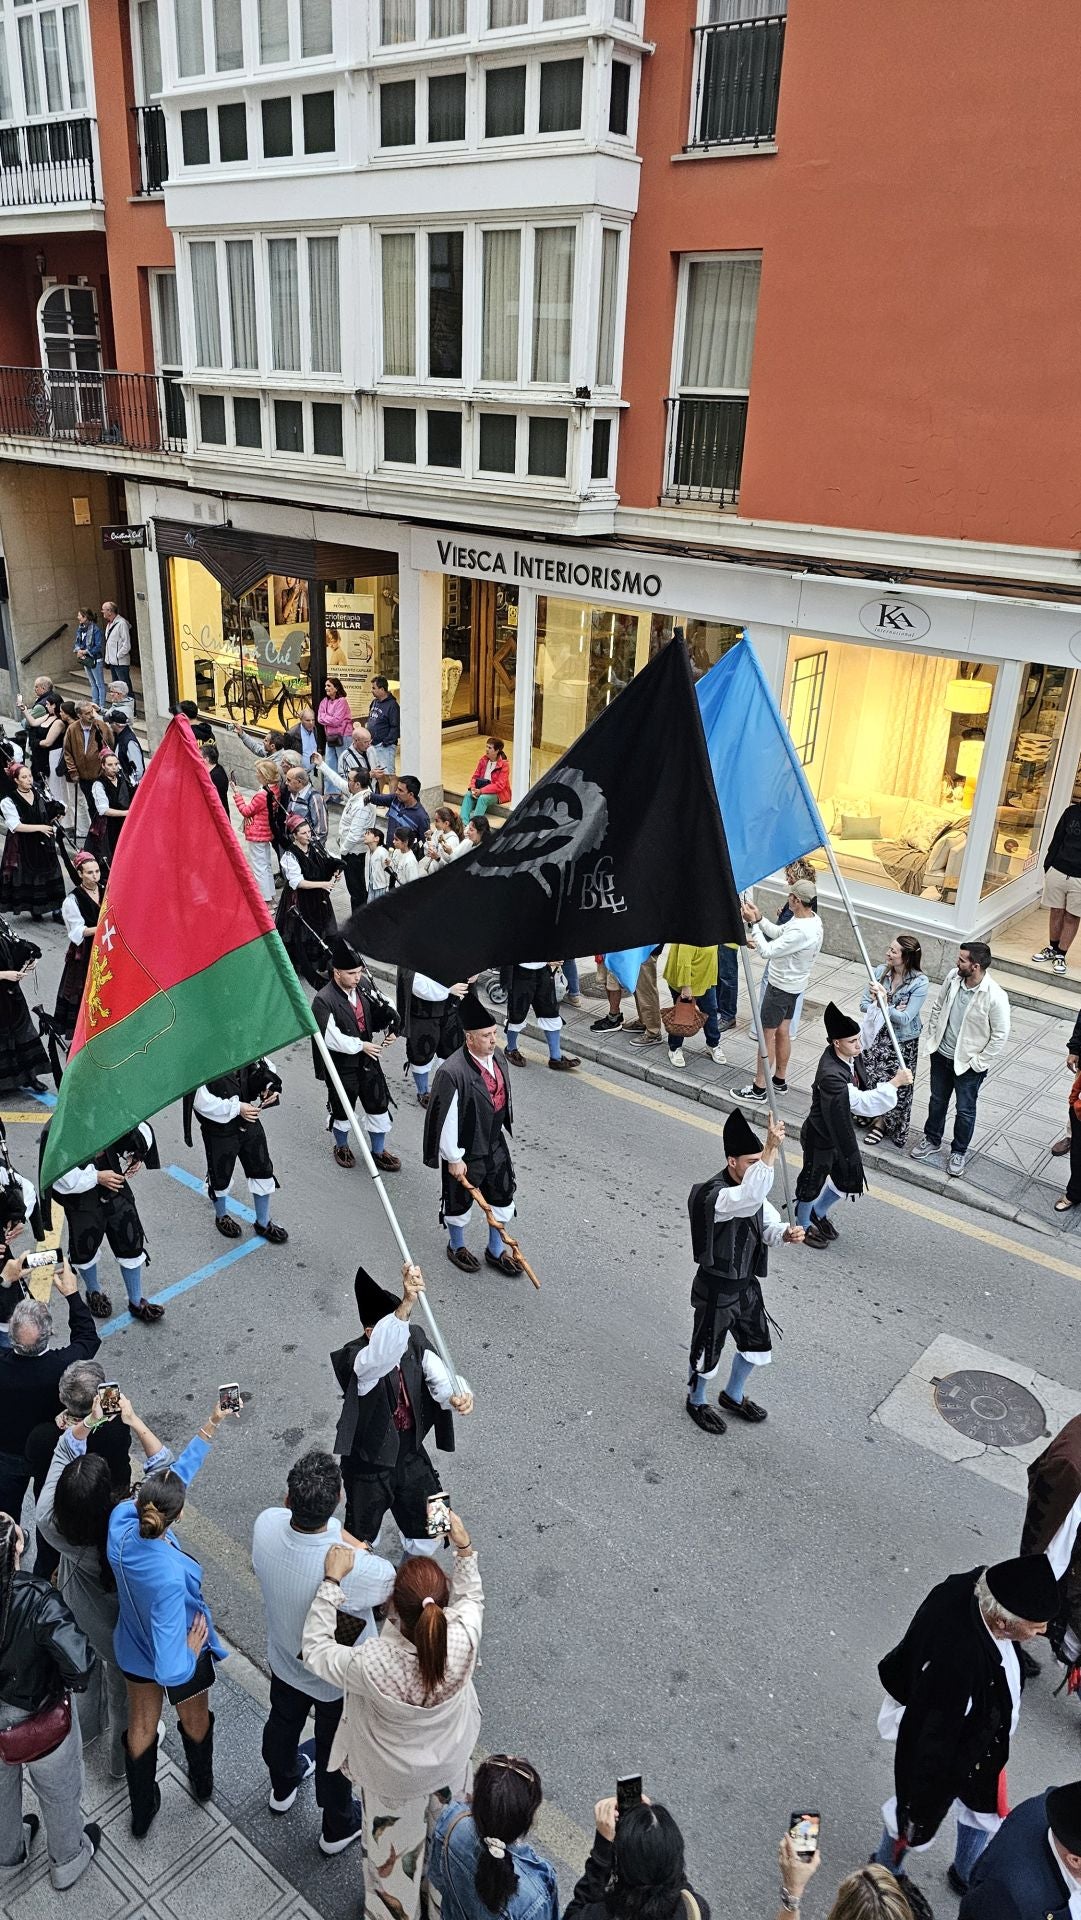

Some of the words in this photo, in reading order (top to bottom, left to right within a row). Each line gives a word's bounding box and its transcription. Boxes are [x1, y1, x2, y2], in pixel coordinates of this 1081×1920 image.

[436, 539, 507, 575] VIESCA
[513, 550, 663, 598] INTERIORISMO
[325, 621, 361, 630] CAPILAR
[876, 603, 916, 631] KA
[200, 624, 261, 659] Cristina
[264, 639, 292, 666] Cué
